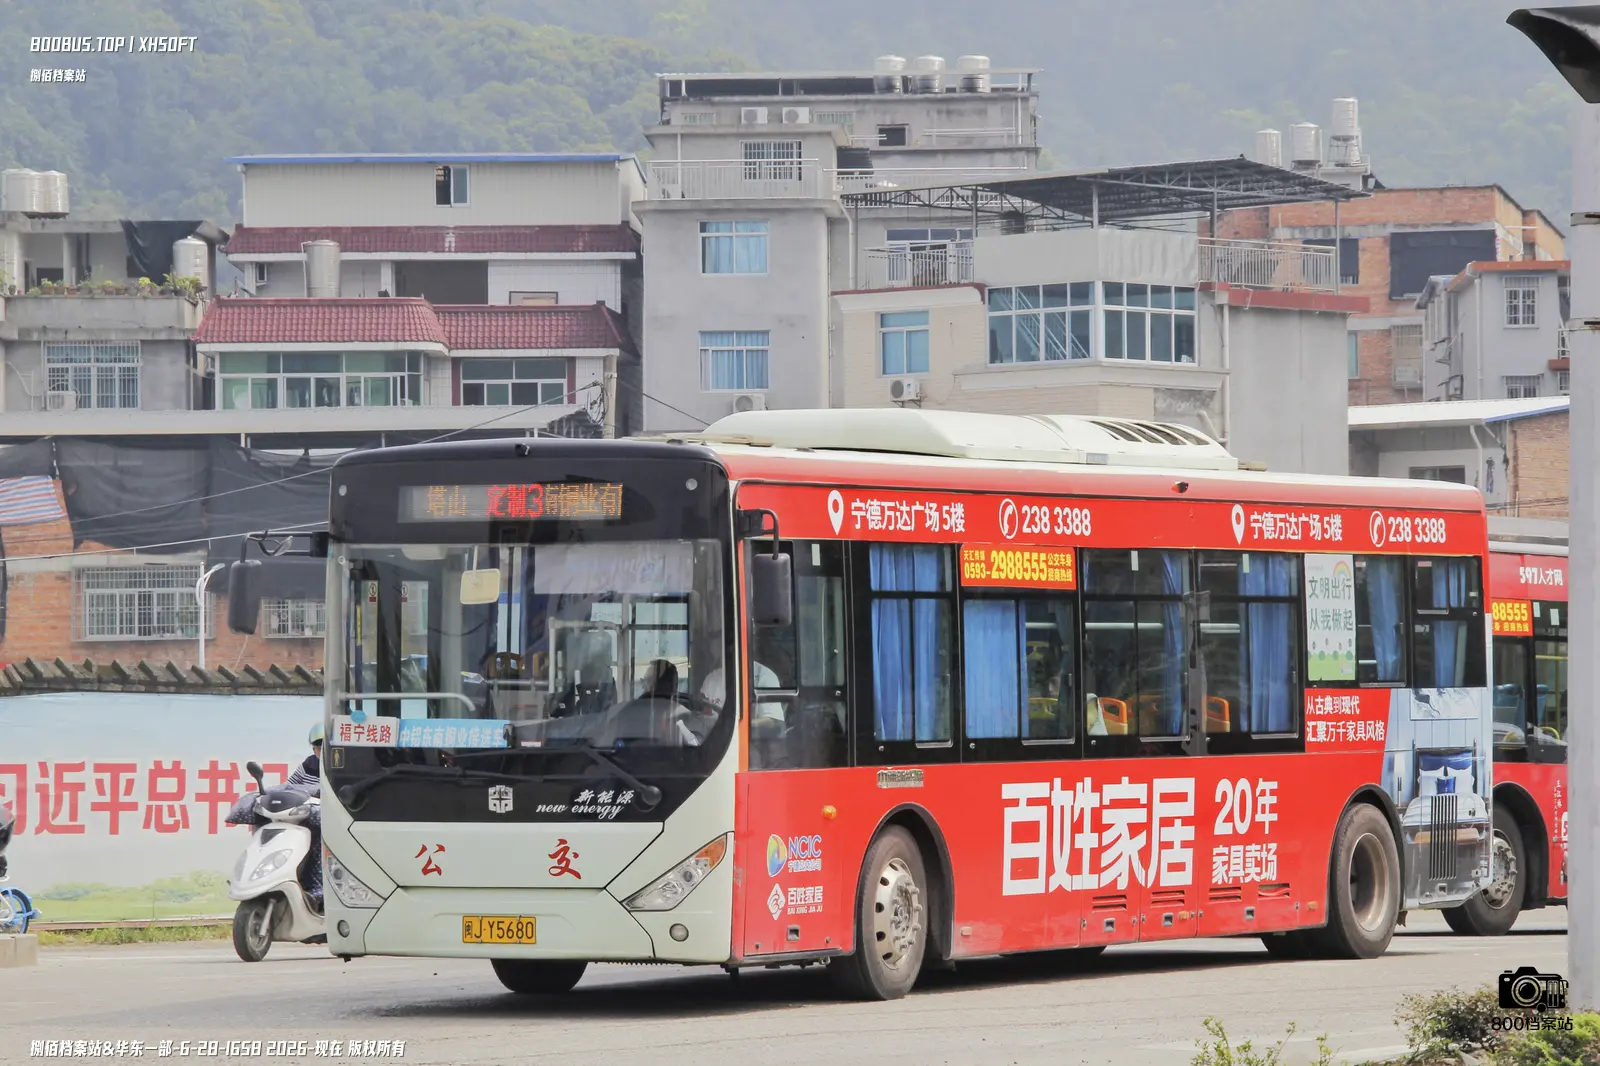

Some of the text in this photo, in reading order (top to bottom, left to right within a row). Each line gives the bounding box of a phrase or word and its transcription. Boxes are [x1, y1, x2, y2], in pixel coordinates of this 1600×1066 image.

[486, 484, 544, 517] 定制3
[851, 498, 965, 533] 宁德万达广场 5楼
[1021, 505, 1091, 536] 238 3388
[1250, 511, 1343, 541] 宁德万达广场 5楼
[1388, 516, 1446, 543] 238 3388
[1047, 554, 1072, 567] 公交车身
[1047, 569, 1073, 582] 招商热线
[1520, 566, 1563, 586] 597人才网
[1308, 576, 1352, 600] 文明出行
[1309, 608, 1353, 632] 从我做起
[1306, 695, 1360, 715] 从古典到现代
[340, 723, 392, 744] 福宁线路
[1307, 721, 1385, 742] 汇聚万千家具风格
[574, 788, 635, 804] 新能源
[1213, 777, 1279, 836] 20年
[536, 801, 624, 820] new energy
[788, 835, 822, 859] NCIC
[1001, 776, 1196, 896] 百姓家居
[1212, 843, 1278, 885] 家具卖场
[787, 886, 823, 905] 百姓家居
